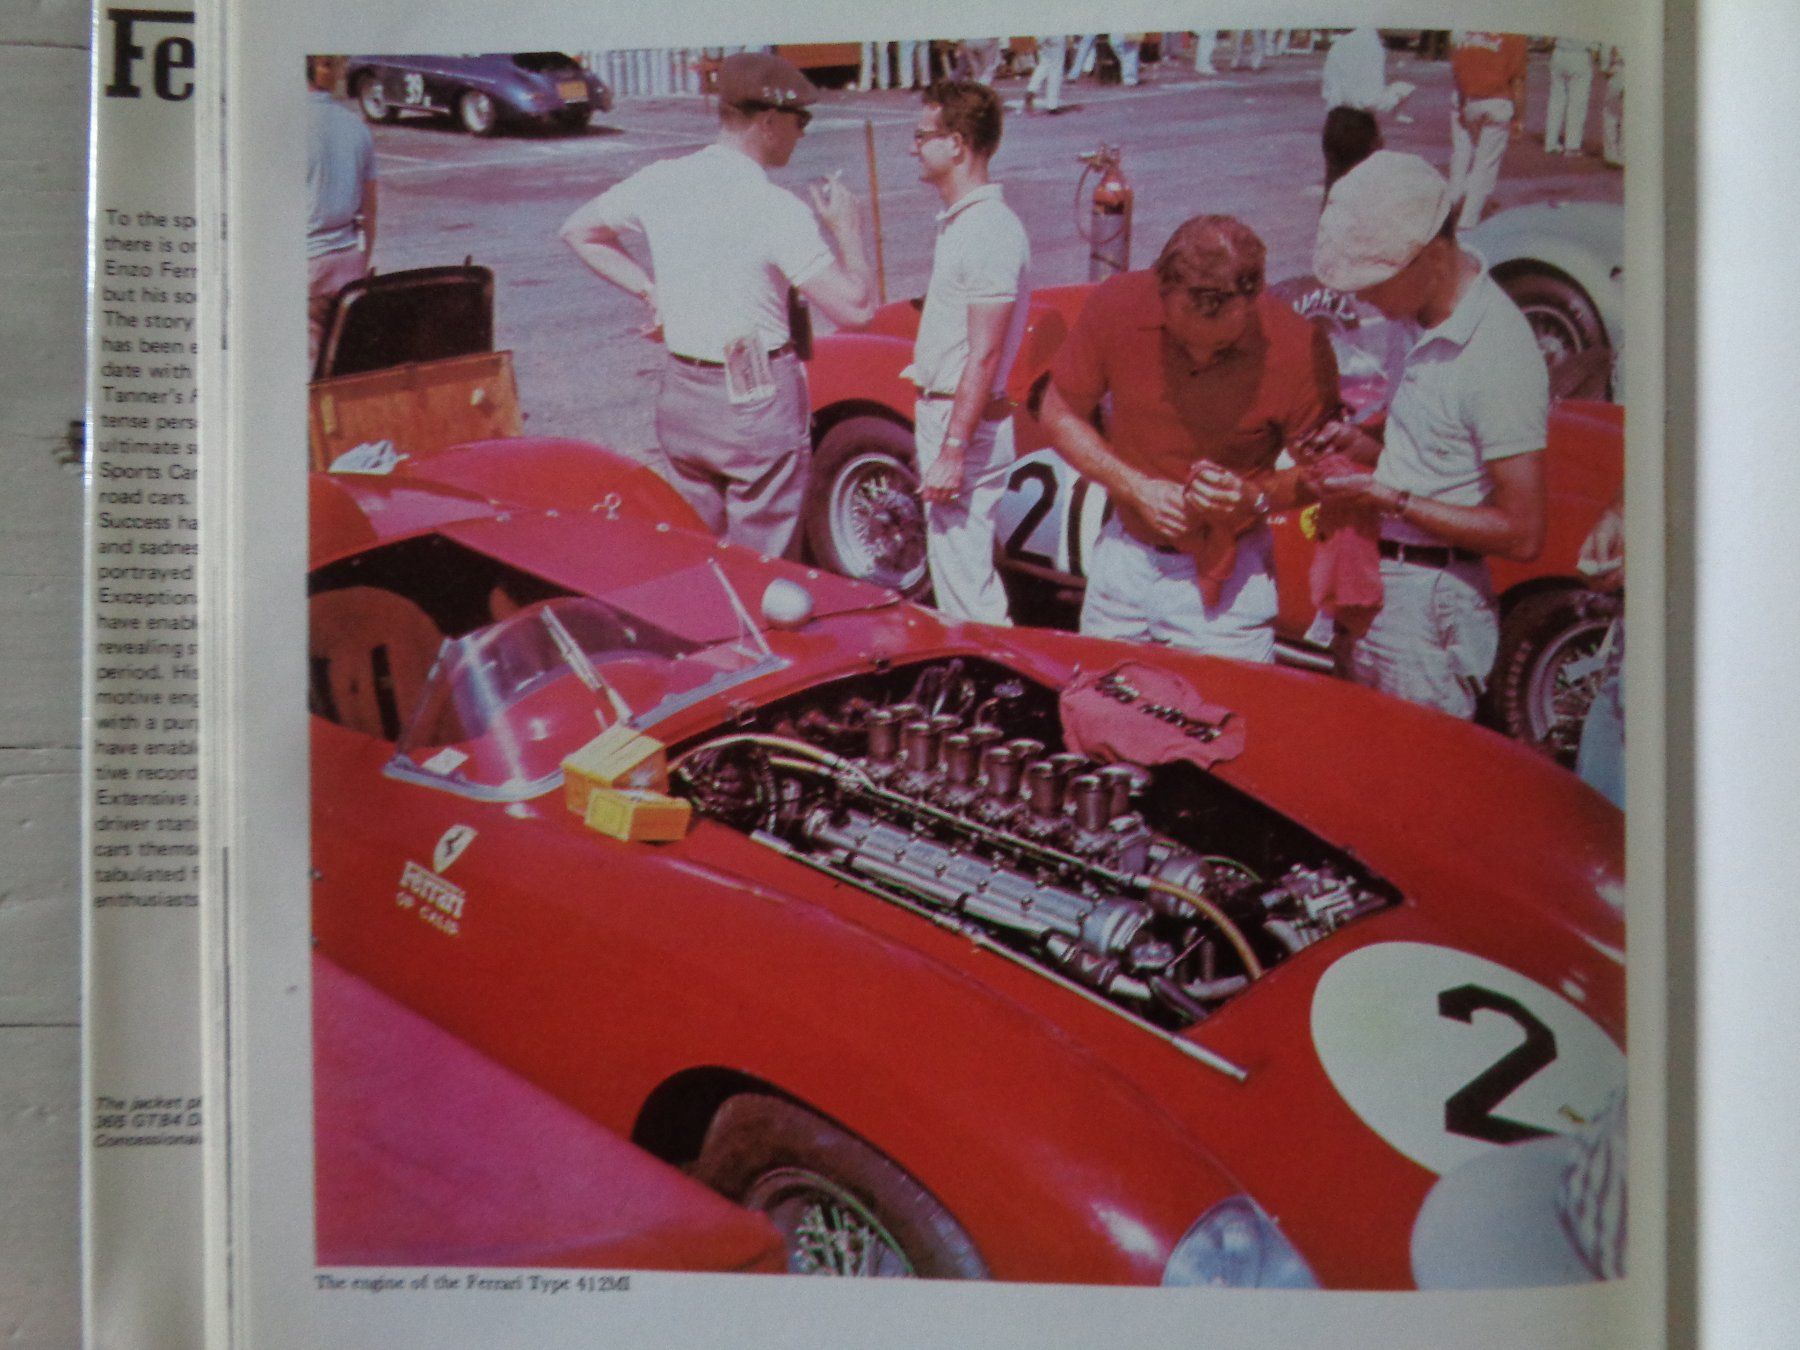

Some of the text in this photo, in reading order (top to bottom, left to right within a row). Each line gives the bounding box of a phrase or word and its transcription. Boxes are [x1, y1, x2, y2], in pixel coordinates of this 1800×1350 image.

[105, 8, 195, 101] Fe
[104, 209, 196, 230] To the sp
[104, 235, 152, 252] there
[159, 236, 174, 252] is
[104, 259, 152, 277] Enzo
[103, 286, 135, 301] but
[141, 287, 168, 303] his
[103, 310, 194, 332] The story
[102, 337, 132, 352] has
[139, 338, 184, 354] been
[101, 362, 192, 378] date with
[102, 386, 184, 404] Tanner's
[100, 415, 150, 428] tense
[99, 439, 182, 454] ultimate
[99, 461, 161, 481] Sports
[99, 489, 191, 505] road cars.
[99, 512, 171, 529] Success
[98, 539, 133, 554] and
[98, 565, 194, 583] portrayed
[97, 614, 142, 630] have
[97, 639, 185, 659] revealing
[96, 663, 164, 681] period.
[95, 690, 162, 704] motive
[97, 714, 140, 730] with
[145, 718, 157, 730] a
[95, 740, 138, 755] have
[96, 788, 187, 806] Extensive
[95, 815, 150, 831] driver
[94, 845, 131, 857] cars
[94, 866, 186, 882] tabulated
[1438, 983, 1560, 1146] 2
[96, 1096, 125, 1110] The
[315, 1274, 347, 1290] The
[351, 1275, 404, 1293] engine
[410, 1273, 430, 1290] of
[434, 1274, 461, 1290] the
[465, 1274, 523, 1290] Ferrari
[527, 1275, 570, 1294] Type
